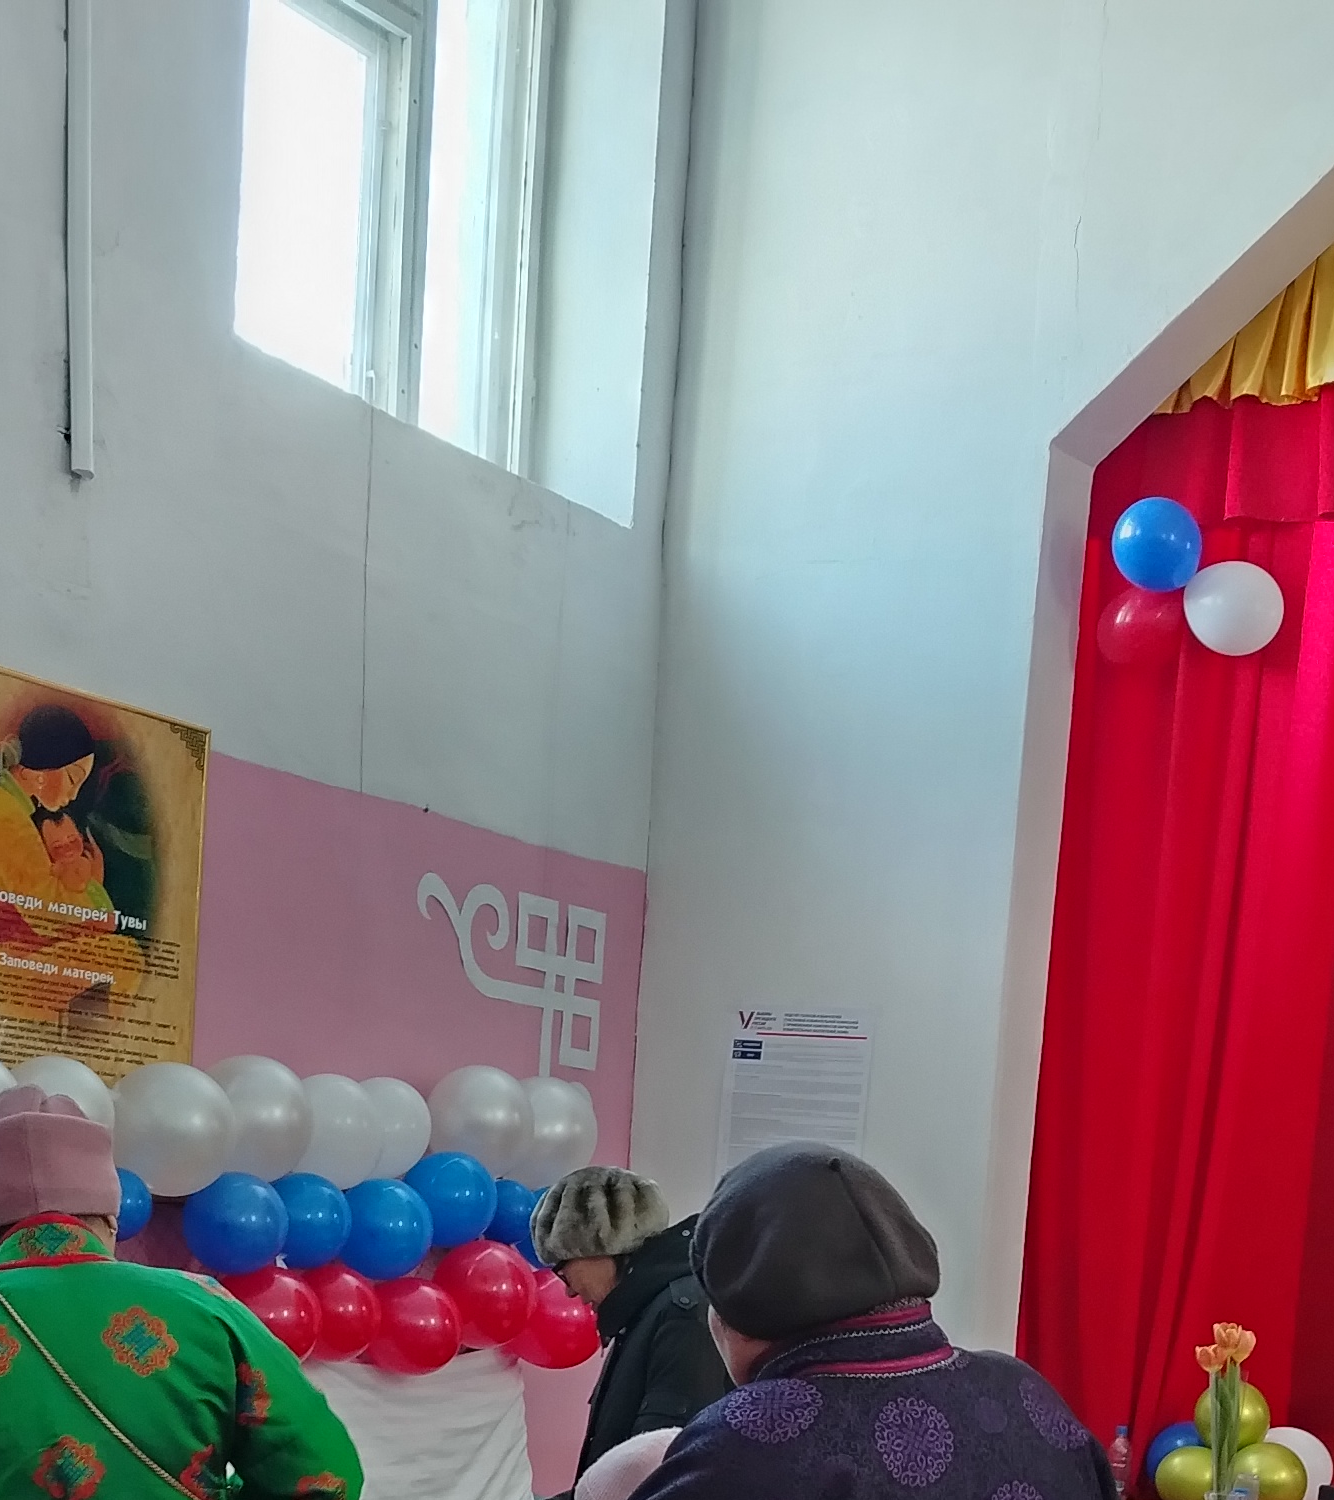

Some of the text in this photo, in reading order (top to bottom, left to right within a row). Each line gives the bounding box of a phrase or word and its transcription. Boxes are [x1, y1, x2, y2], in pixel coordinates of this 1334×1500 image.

[48, 901, 107, 923] матерей
[113, 911, 147, 932] Тувы
[62, 967, 117, 984] матерей.
